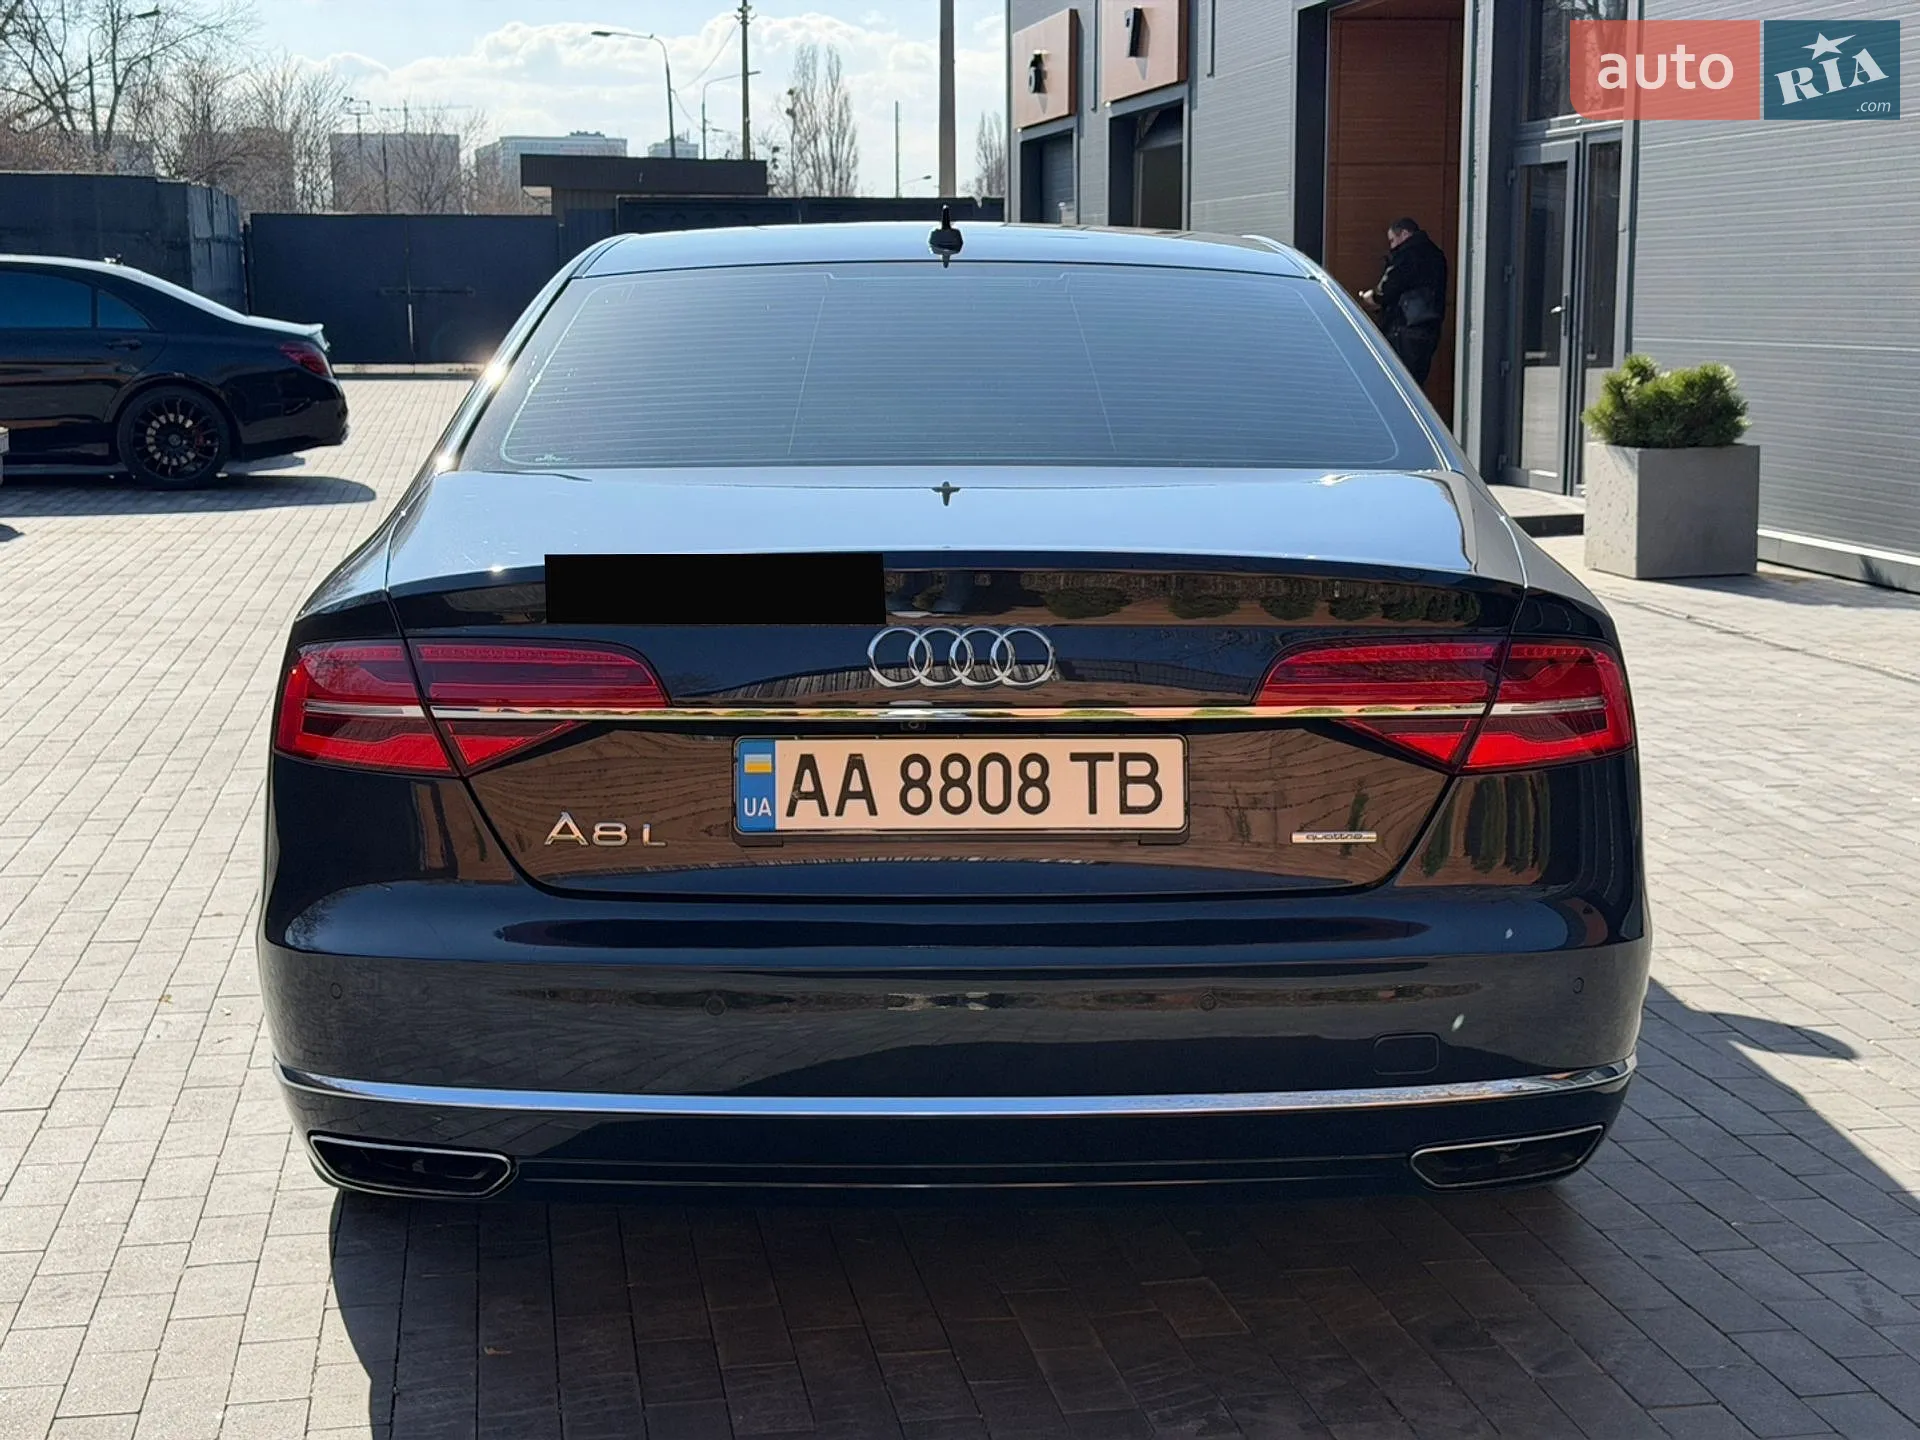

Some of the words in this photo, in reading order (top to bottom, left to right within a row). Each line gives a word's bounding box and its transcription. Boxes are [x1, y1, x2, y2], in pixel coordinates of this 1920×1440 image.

[786, 753, 878, 817] AA
[899, 752, 1051, 816] 8808
[1070, 752, 1163, 815] TB
[744, 798, 772, 817] UA
